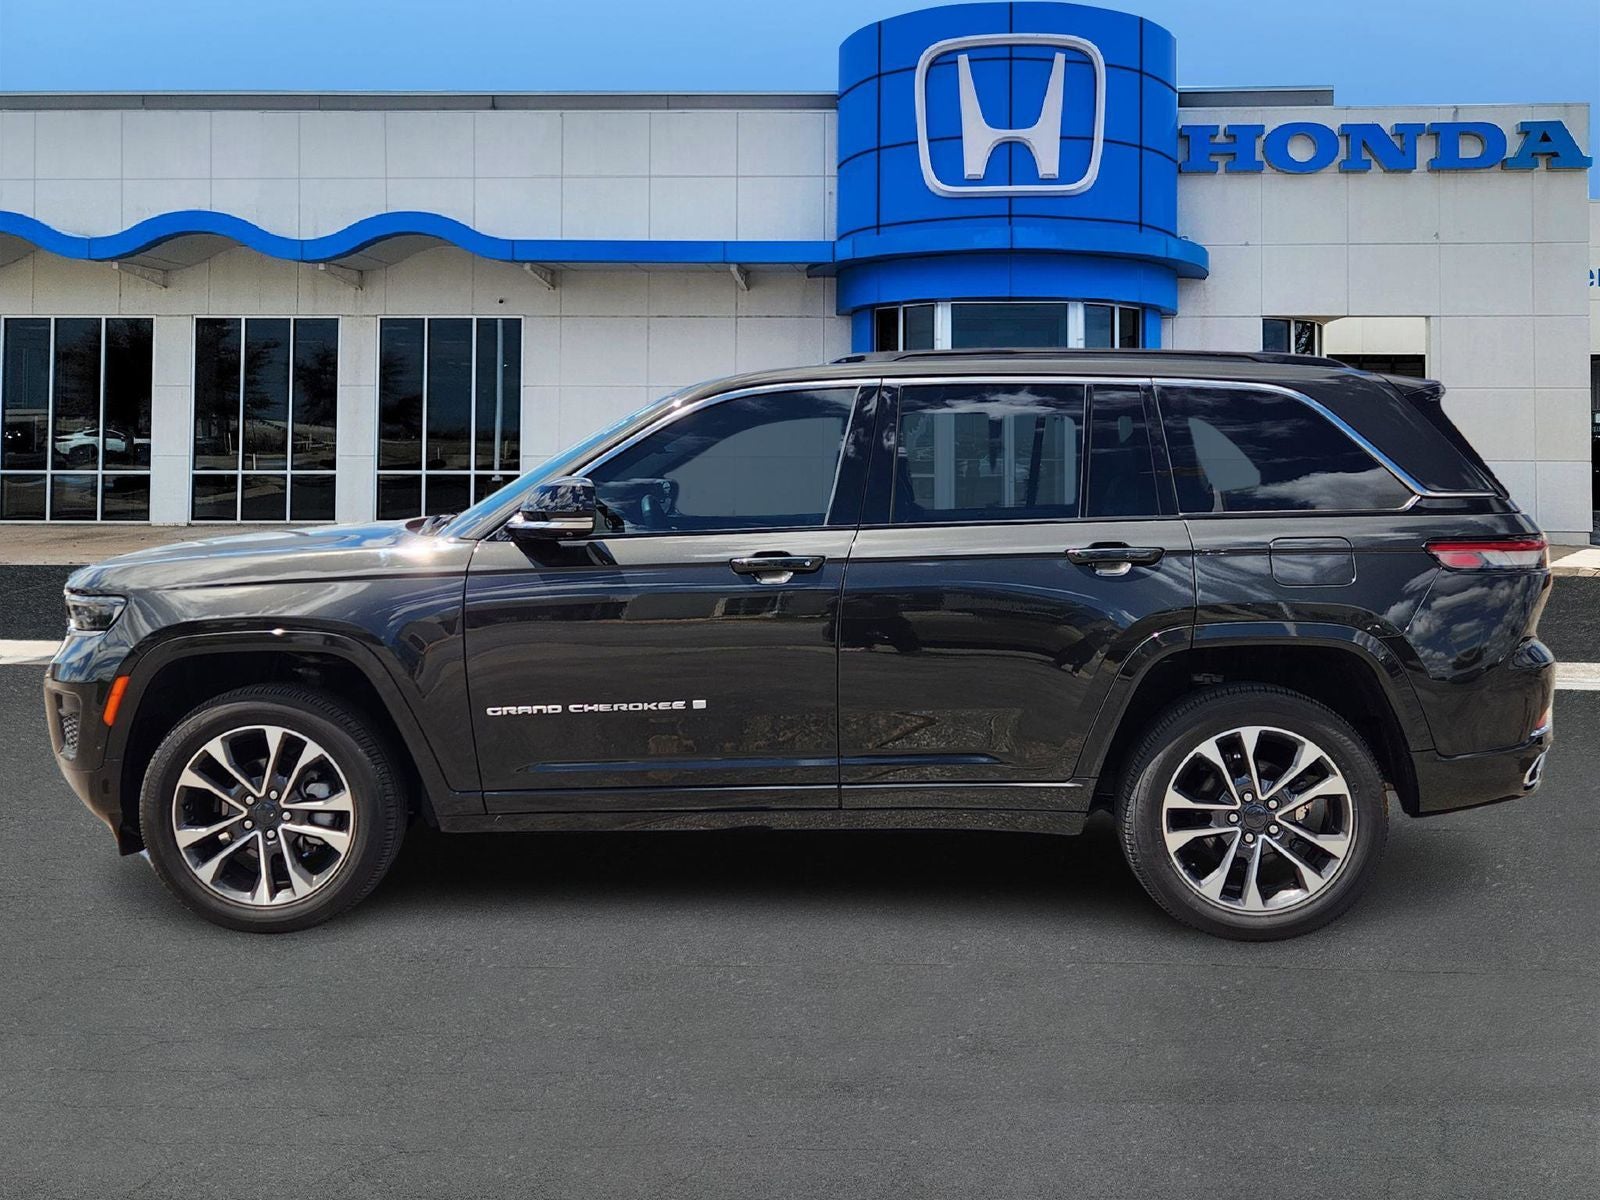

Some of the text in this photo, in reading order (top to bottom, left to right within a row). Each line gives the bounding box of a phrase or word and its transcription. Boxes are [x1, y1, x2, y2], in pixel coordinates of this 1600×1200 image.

[1179, 120, 1593, 174] HONDA
[486, 700, 686, 717] GRAND CHEROKEE
